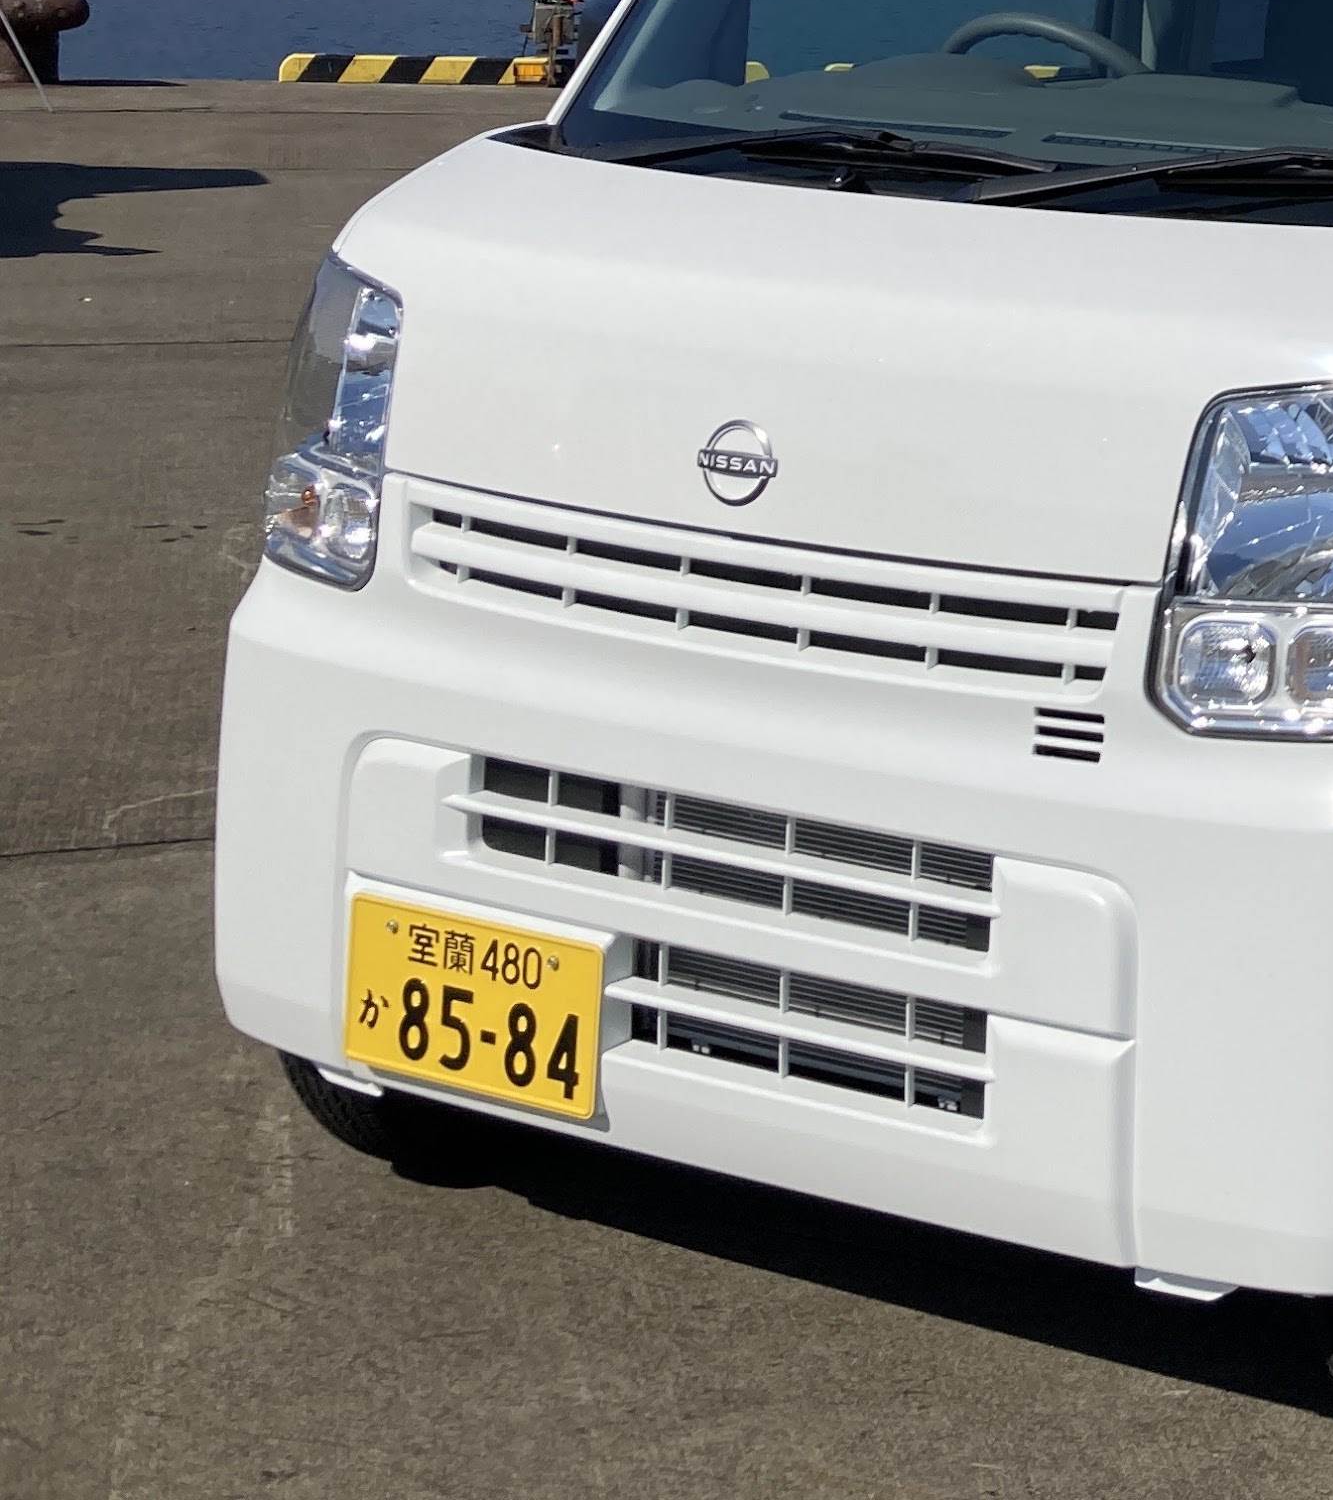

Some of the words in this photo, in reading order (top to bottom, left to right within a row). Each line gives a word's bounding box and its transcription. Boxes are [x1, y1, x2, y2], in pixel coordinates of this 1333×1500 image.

[699, 451, 776, 475] NISSAN
[408, 923, 476, 976] 室蘭
[481, 939, 543, 990] 480
[359, 988, 390, 1029] か
[398, 977, 580, 1101] 85-84
